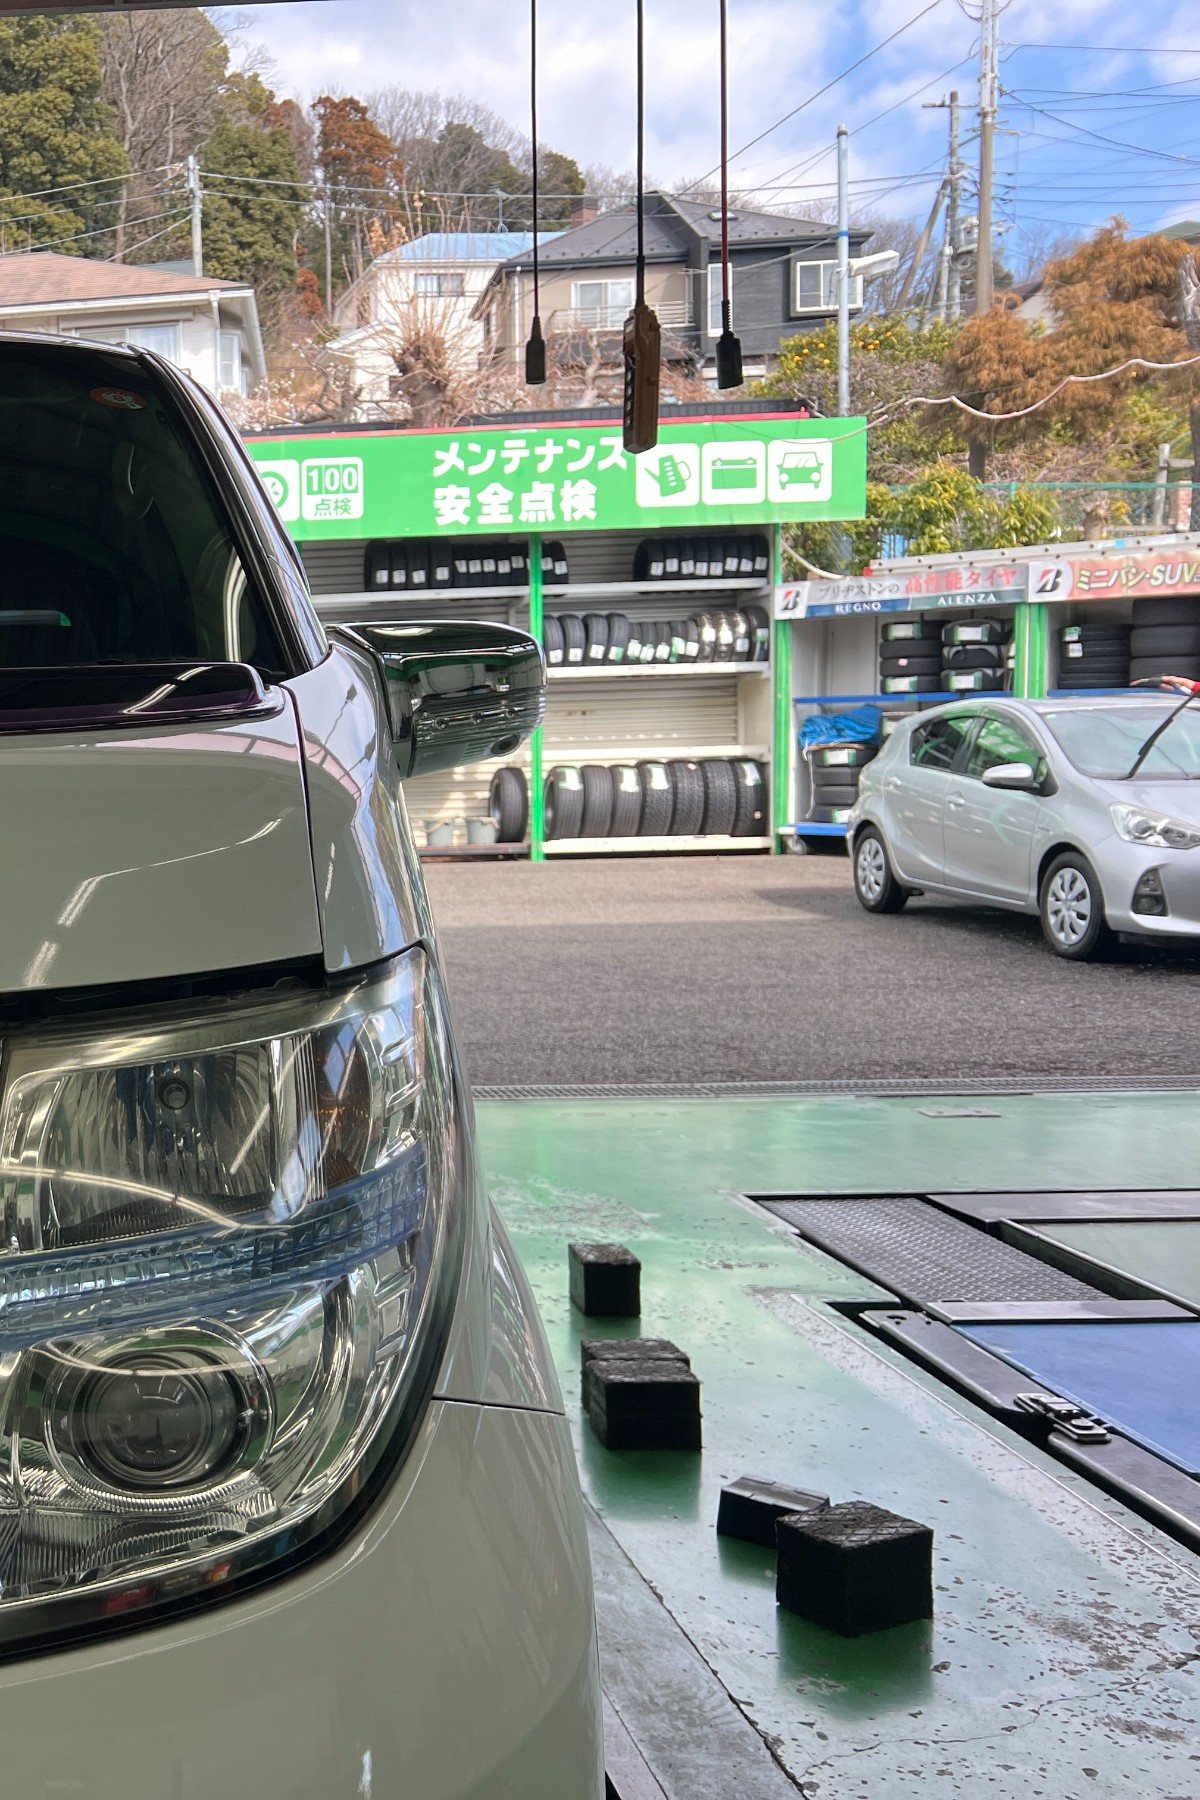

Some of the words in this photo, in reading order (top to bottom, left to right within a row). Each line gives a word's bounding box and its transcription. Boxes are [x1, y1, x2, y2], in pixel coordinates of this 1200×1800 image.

[432, 436, 627, 477] メンテナンス
[307, 467, 358, 492] 100
[313, 497, 353, 517] 点検
[433, 479, 598, 525] 安全点検
[834, 601, 882, 614] REGNO
[937, 592, 997, 605] ALENZA
